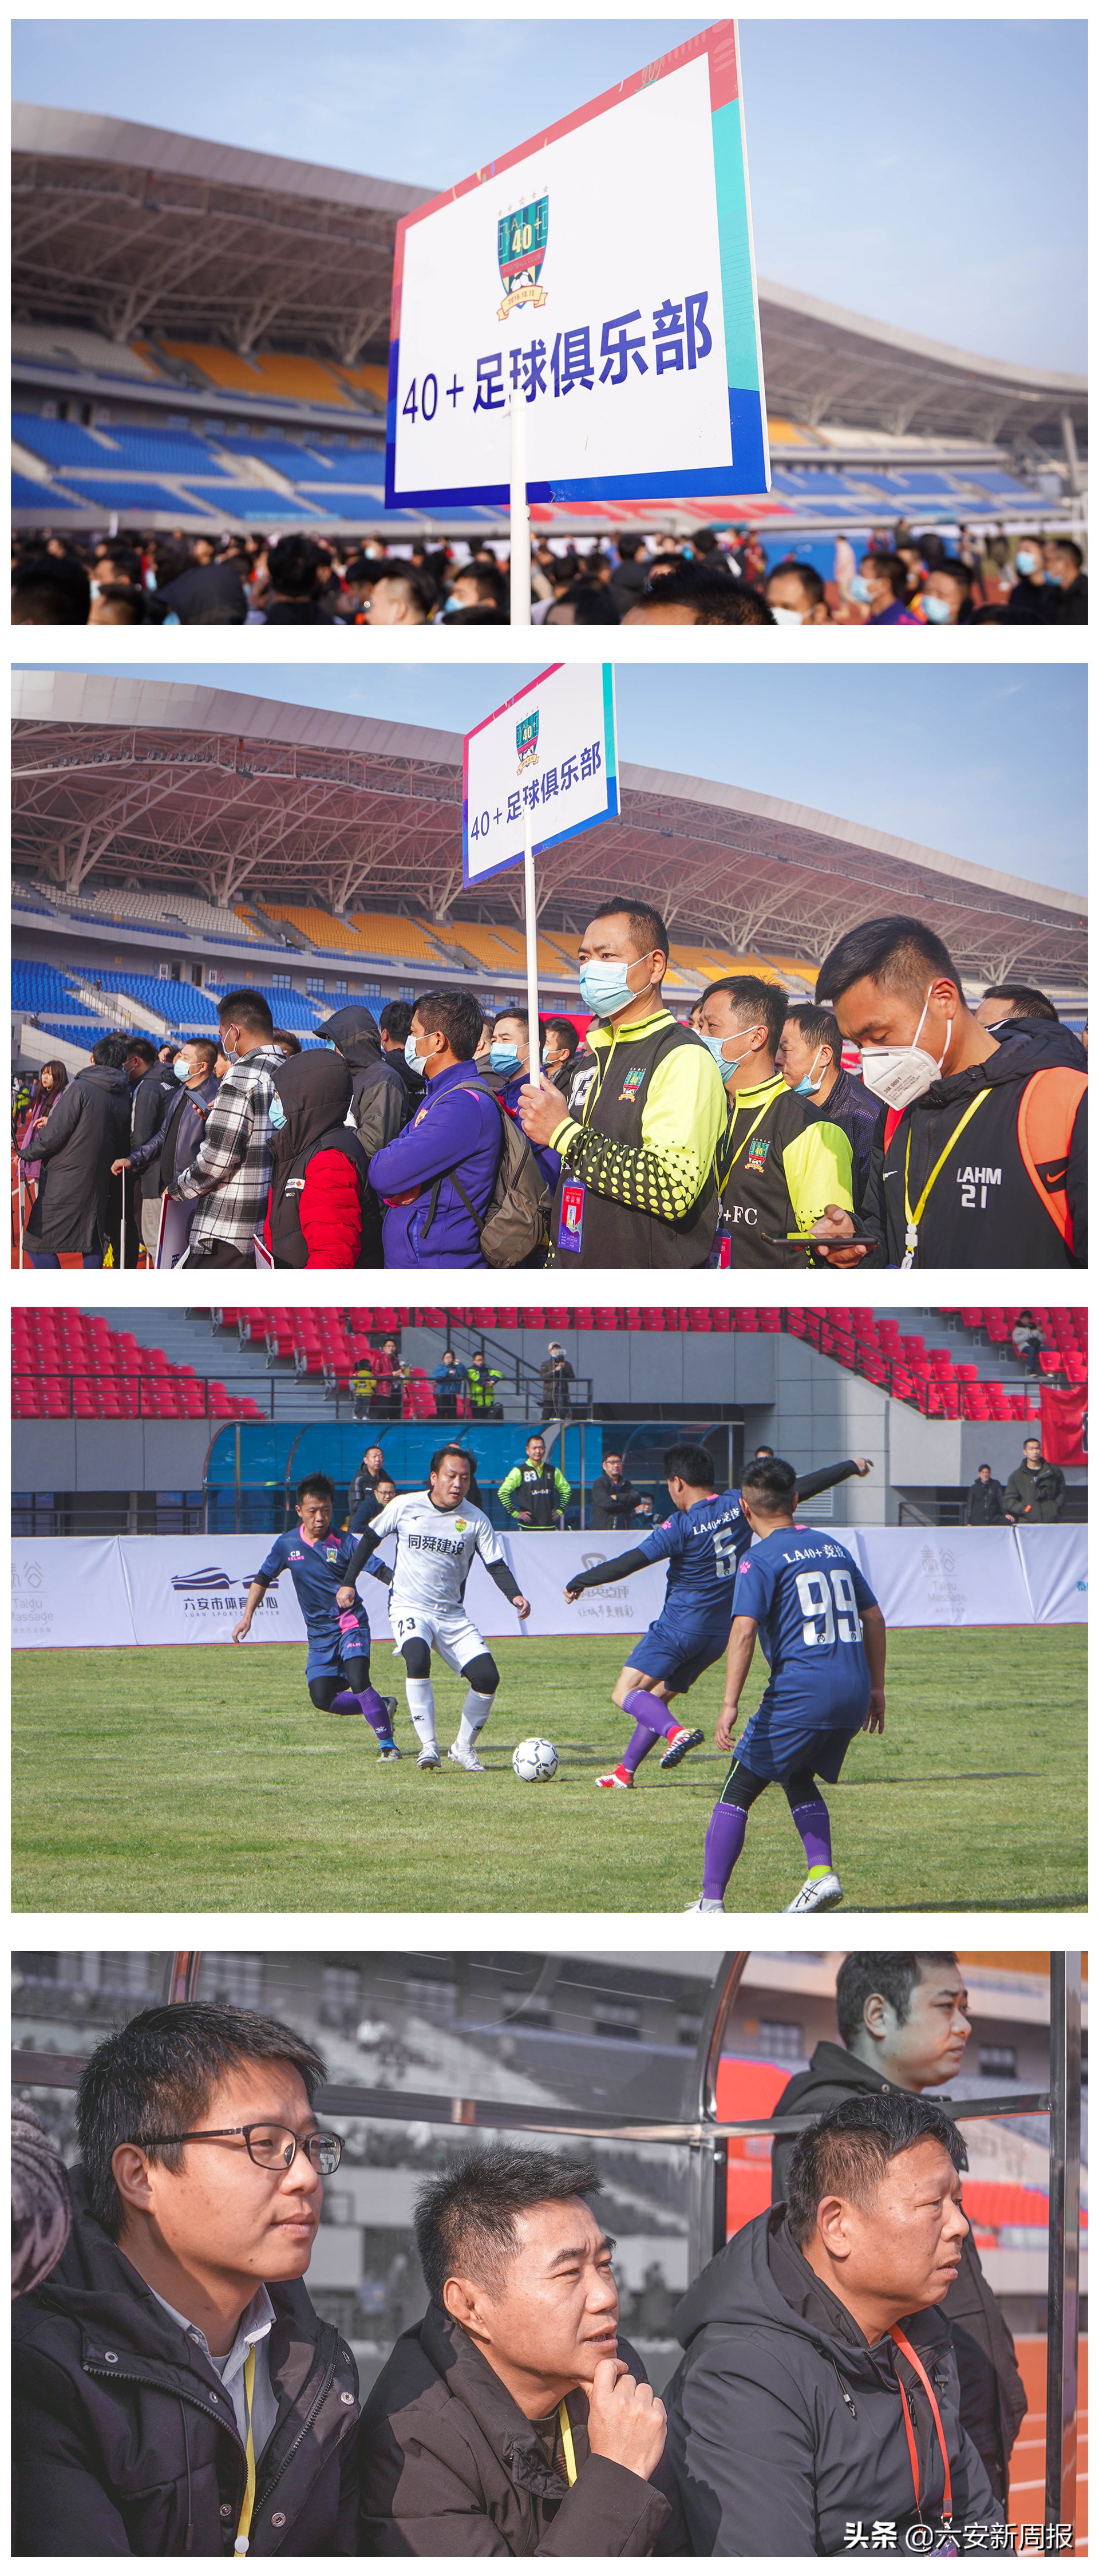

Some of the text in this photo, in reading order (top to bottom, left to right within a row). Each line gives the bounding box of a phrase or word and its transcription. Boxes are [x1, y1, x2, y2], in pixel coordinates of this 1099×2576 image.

[527, 252, 541, 265] CLUB
[508, 289, 535, 306] 2016.10.15
[891, 1077, 902, 1087] 9001
[956, 1167, 1002, 1185] LAHM
[962, 1184, 987, 1208] 21
[719, 1204, 757, 1225] +FC
[524, 1470, 537, 1483] 83
[409, 1534, 465, 1555] 同舜建设
[713, 1527, 737, 1578] 5
[11, 1598, 42, 1613] Taigu
[796, 1570, 862, 1646] 99
[398, 1617, 416, 1638] 23
